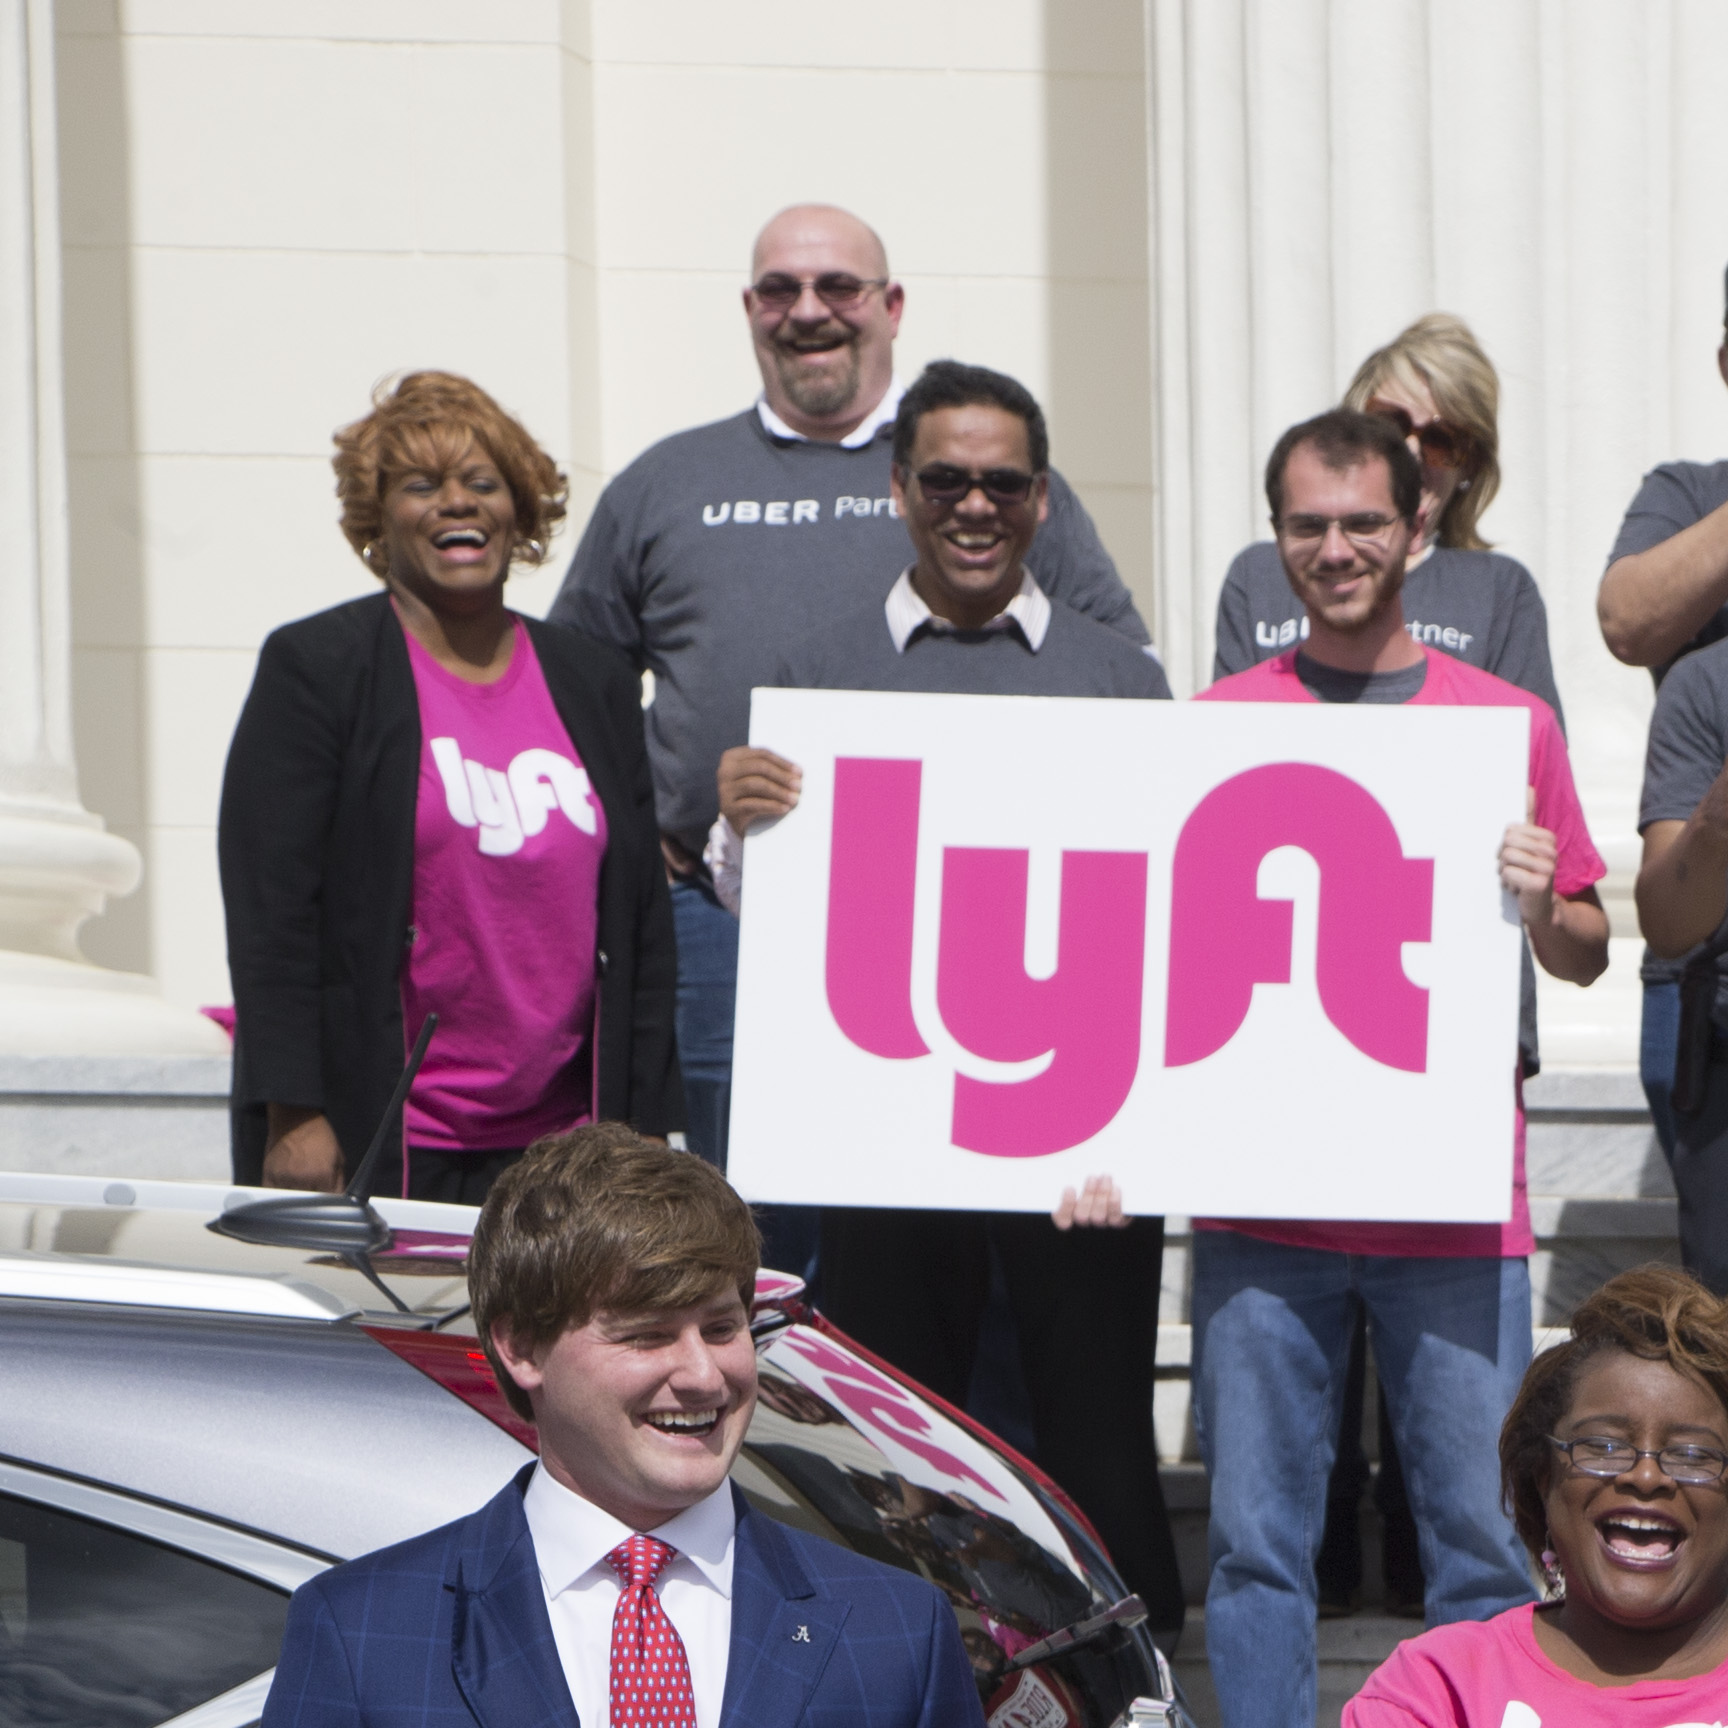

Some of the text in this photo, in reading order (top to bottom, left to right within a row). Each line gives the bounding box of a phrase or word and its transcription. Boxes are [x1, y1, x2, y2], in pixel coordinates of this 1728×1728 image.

[702, 495, 900, 527] UBER Part
[1255, 615, 1475, 651] UB tner
[429, 736, 597, 857] lyft
[825, 755, 1435, 1159] lyft
